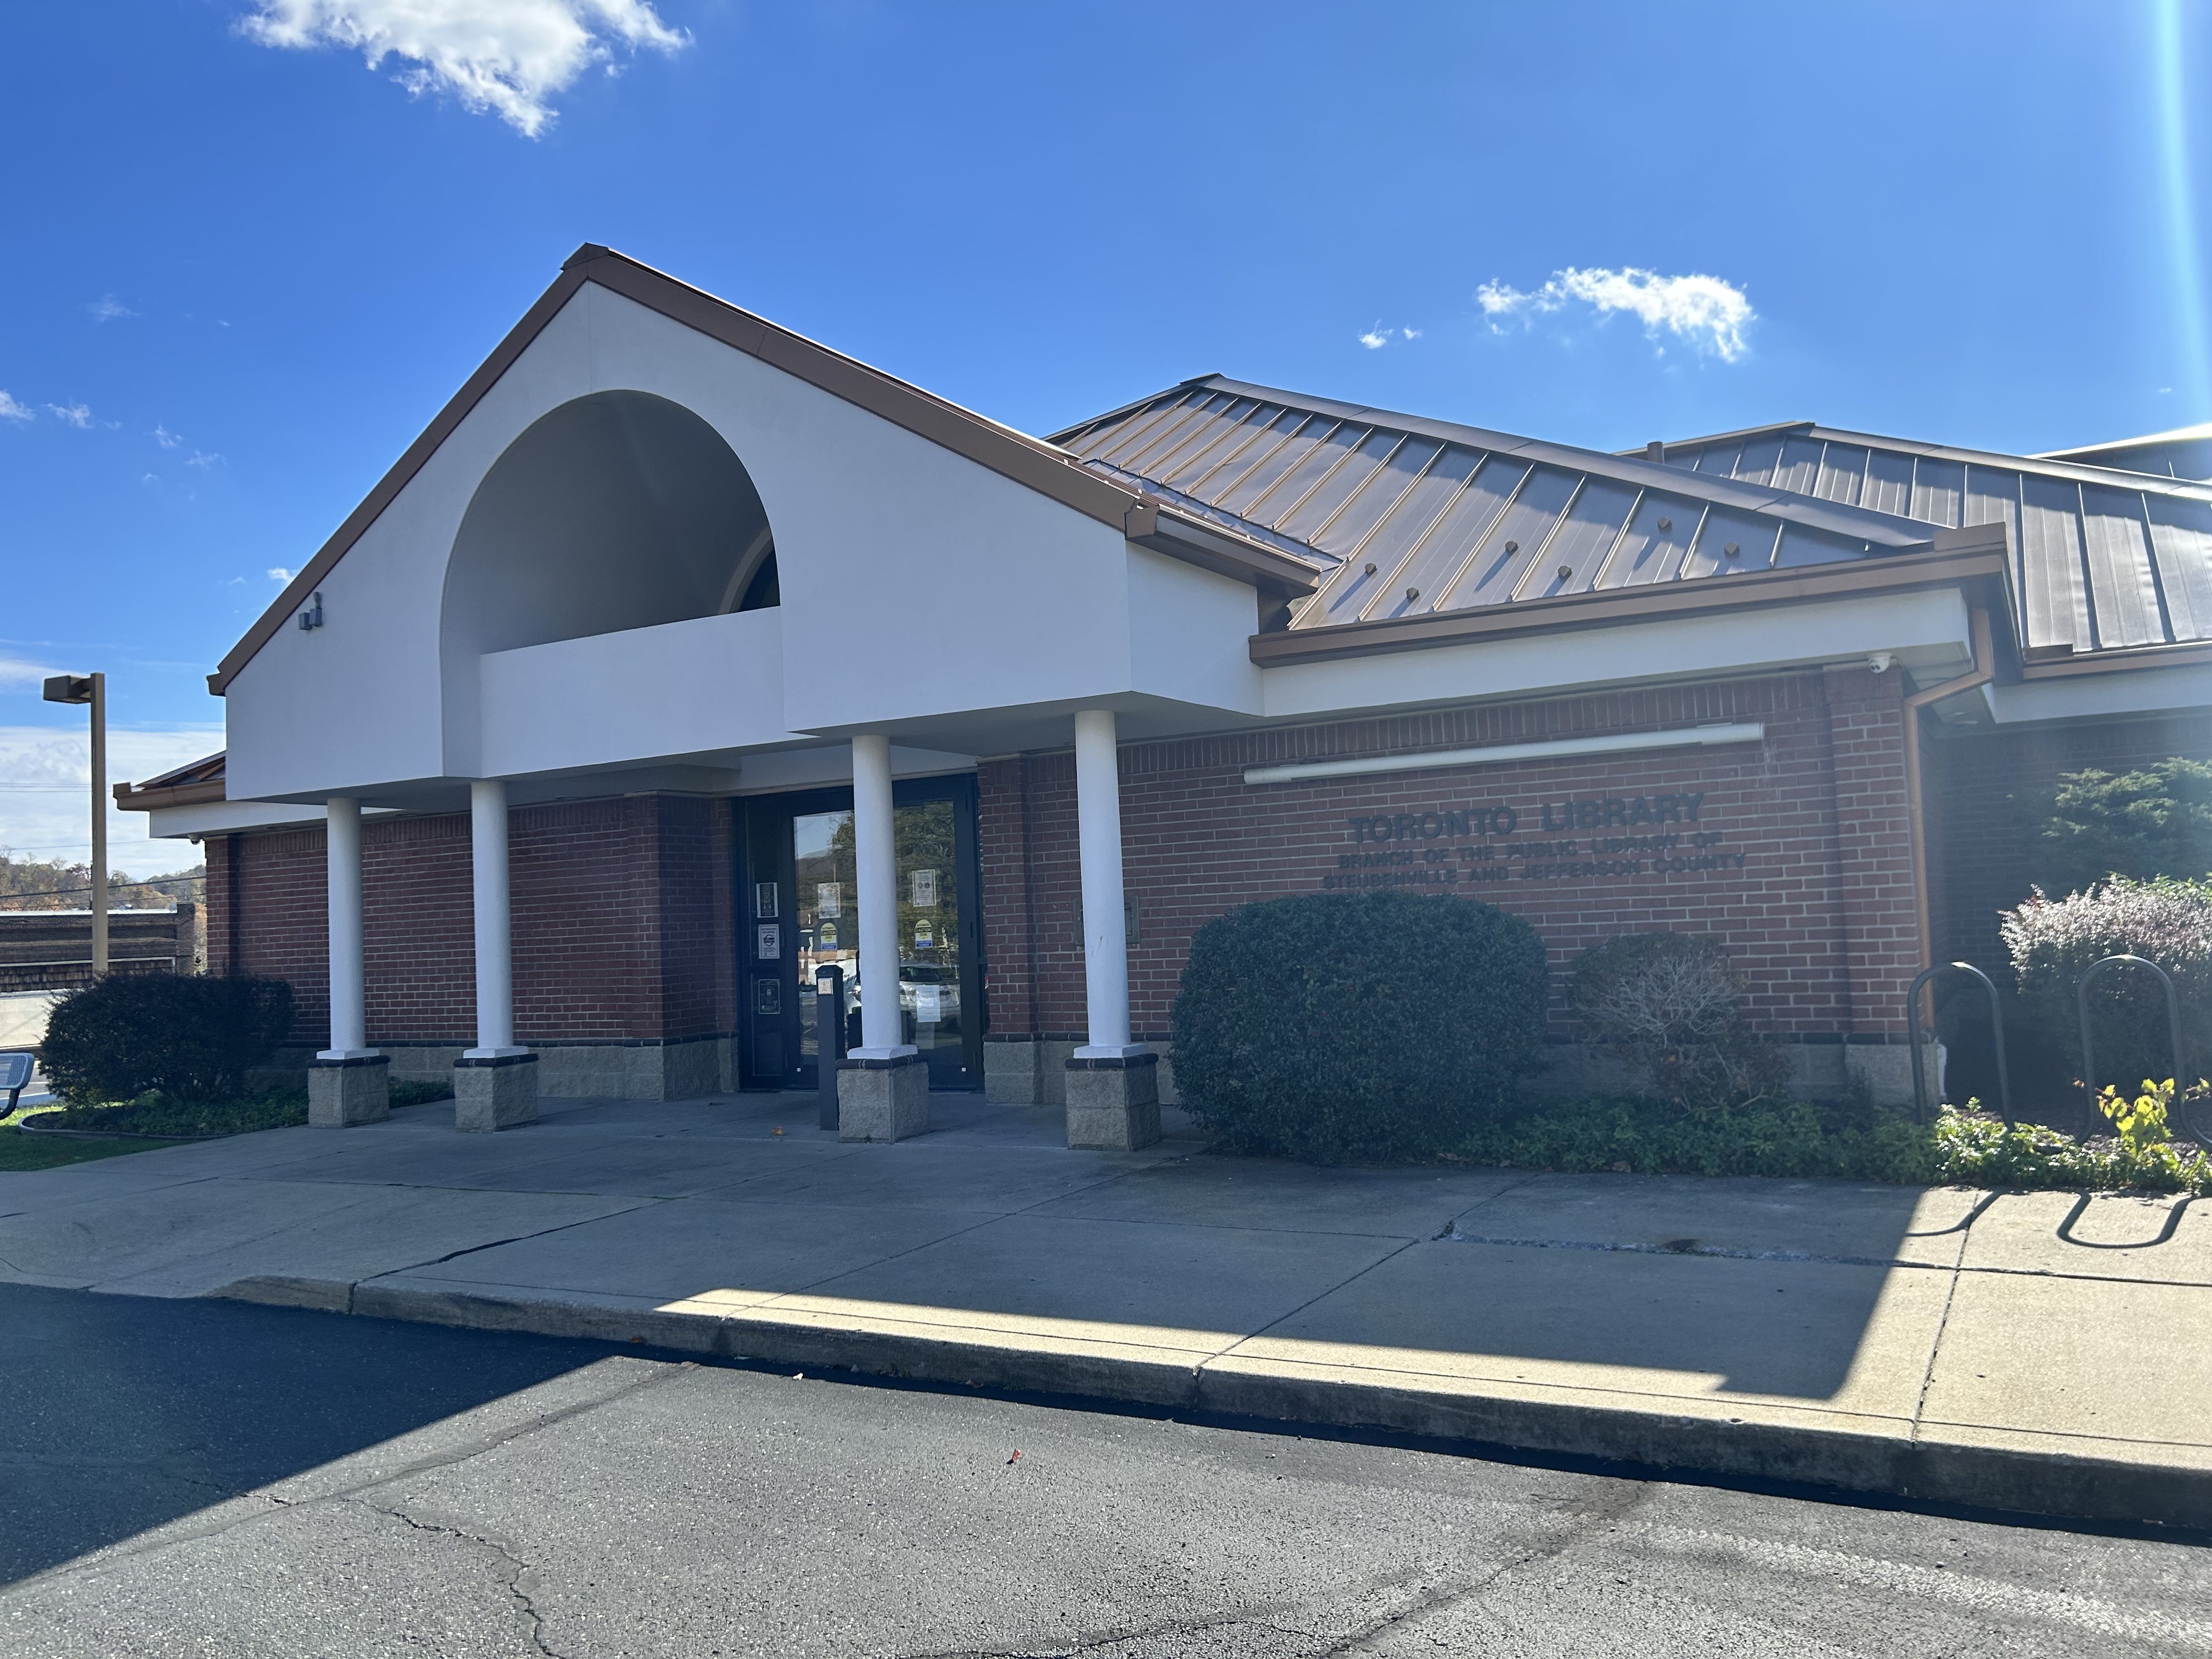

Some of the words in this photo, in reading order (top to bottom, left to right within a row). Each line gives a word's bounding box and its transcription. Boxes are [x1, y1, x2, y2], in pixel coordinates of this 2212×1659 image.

[1350, 806, 1517, 843] TORONTO
[1542, 792, 1705, 831] LIBRARY
[1338, 850, 1414, 868] BRANCH
[1423, 848, 1450, 864] OF
[1458, 845, 1495, 862] THE
[1506, 840, 1578, 859] PUBLIC
[1591, 833, 1680, 854] LIBRARY
[1693, 831, 1723, 849] OF
[1323, 868, 1458, 889] STEUBENVILLE
[1469, 866, 1509, 882] AND
[1520, 859, 1641, 879] JEFFERSON
[1655, 853, 1746, 874] COUNTY
